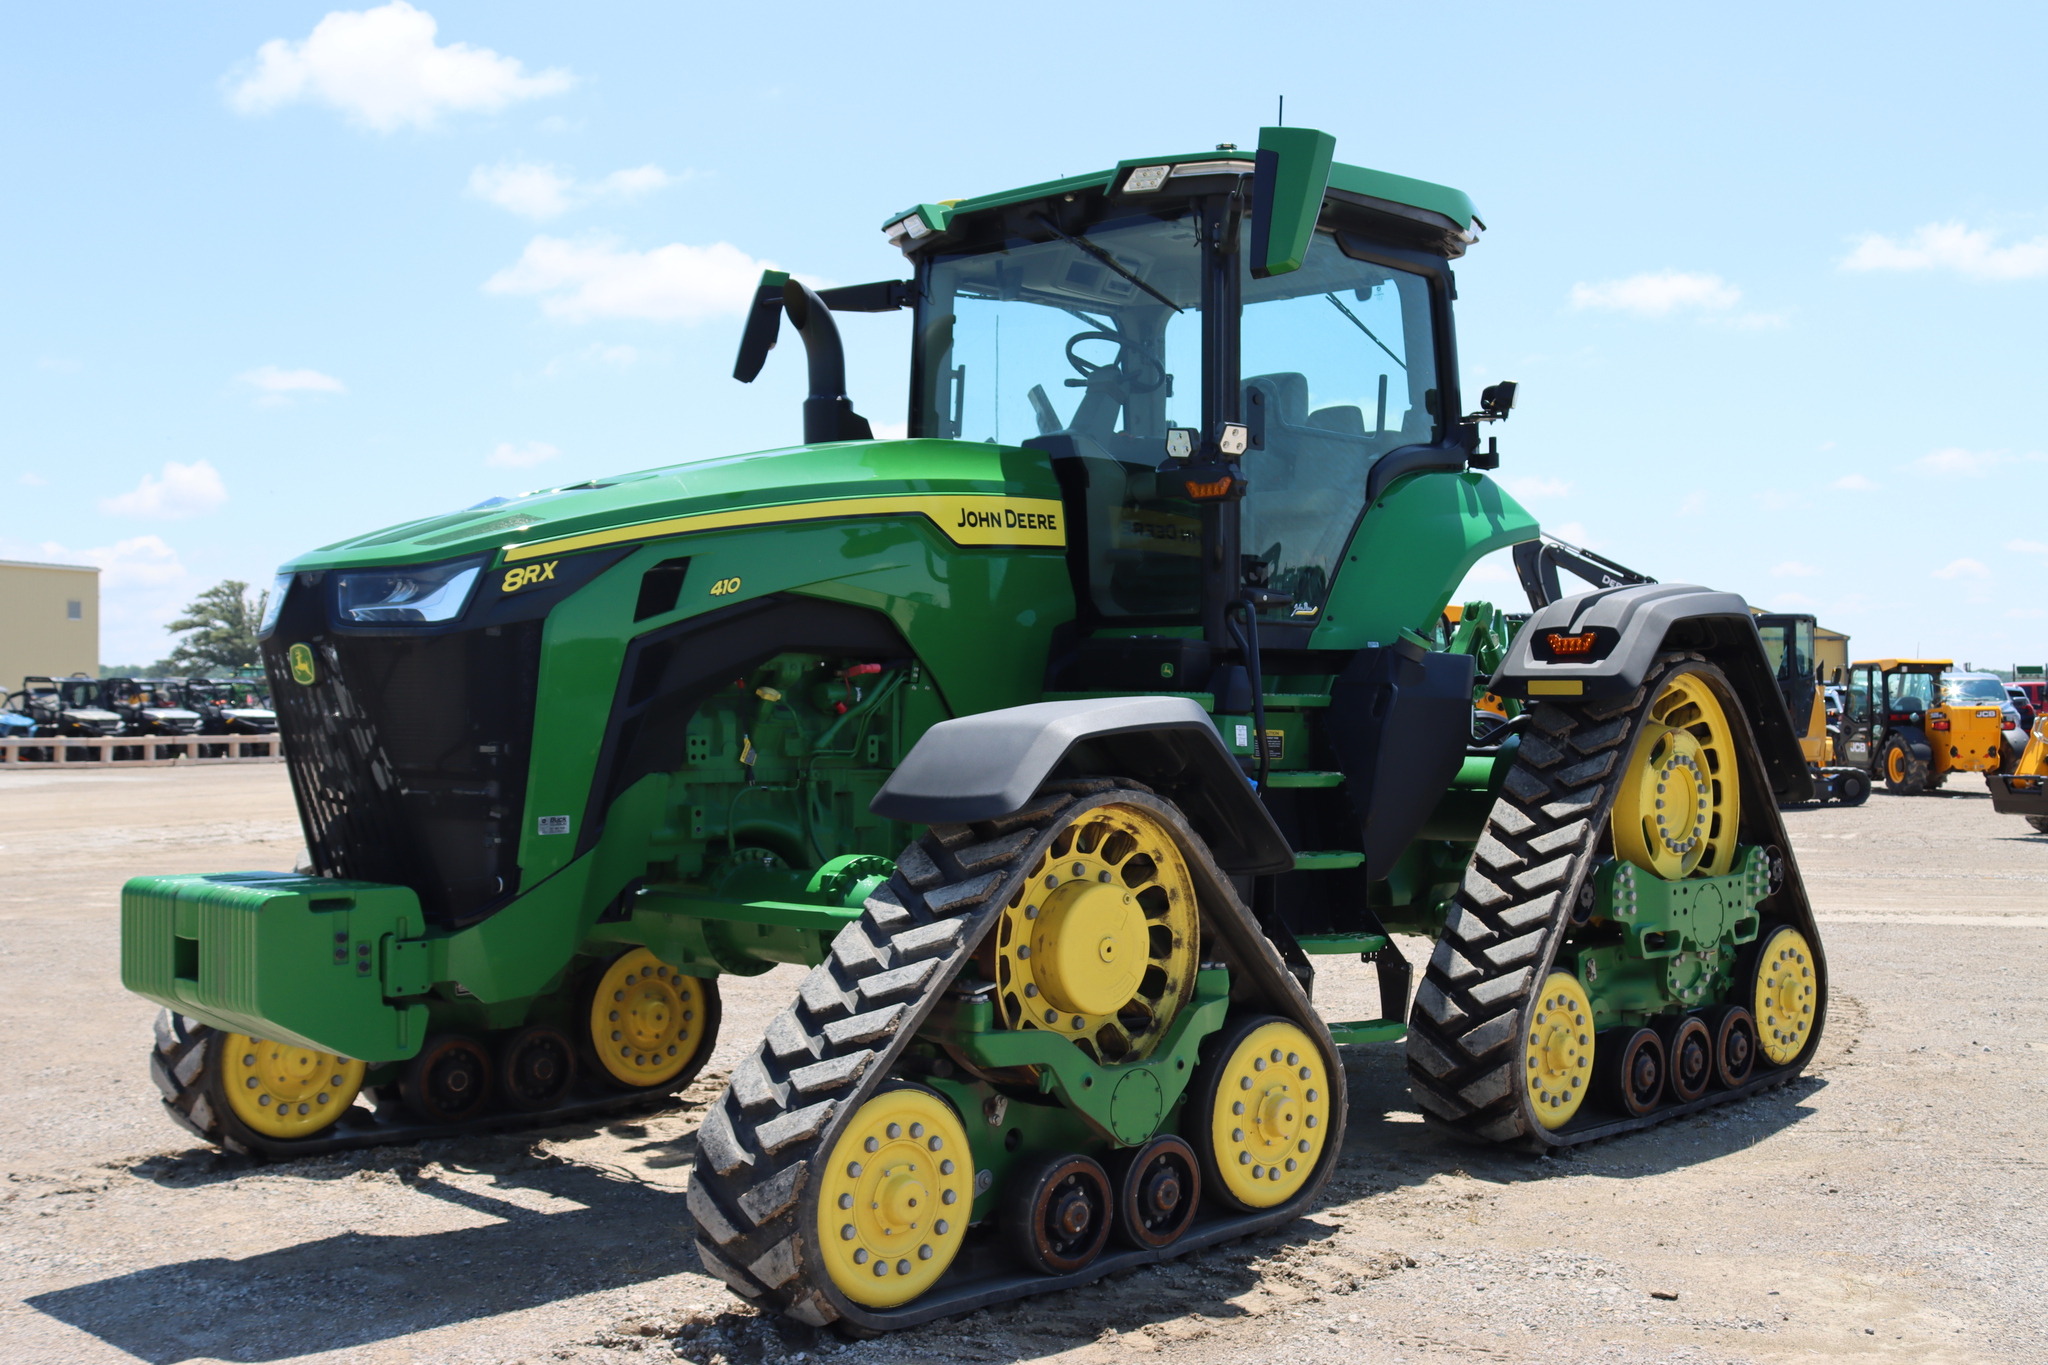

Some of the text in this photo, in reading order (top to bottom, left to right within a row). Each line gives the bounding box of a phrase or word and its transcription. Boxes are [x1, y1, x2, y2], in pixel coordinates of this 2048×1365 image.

[957, 507, 1057, 530] JOHN DEERE
[501, 560, 559, 593] 8RX
[709, 576, 742, 597] 410
[1976, 710, 1996, 718] JCB
[1850, 742, 1866, 752] JCB
